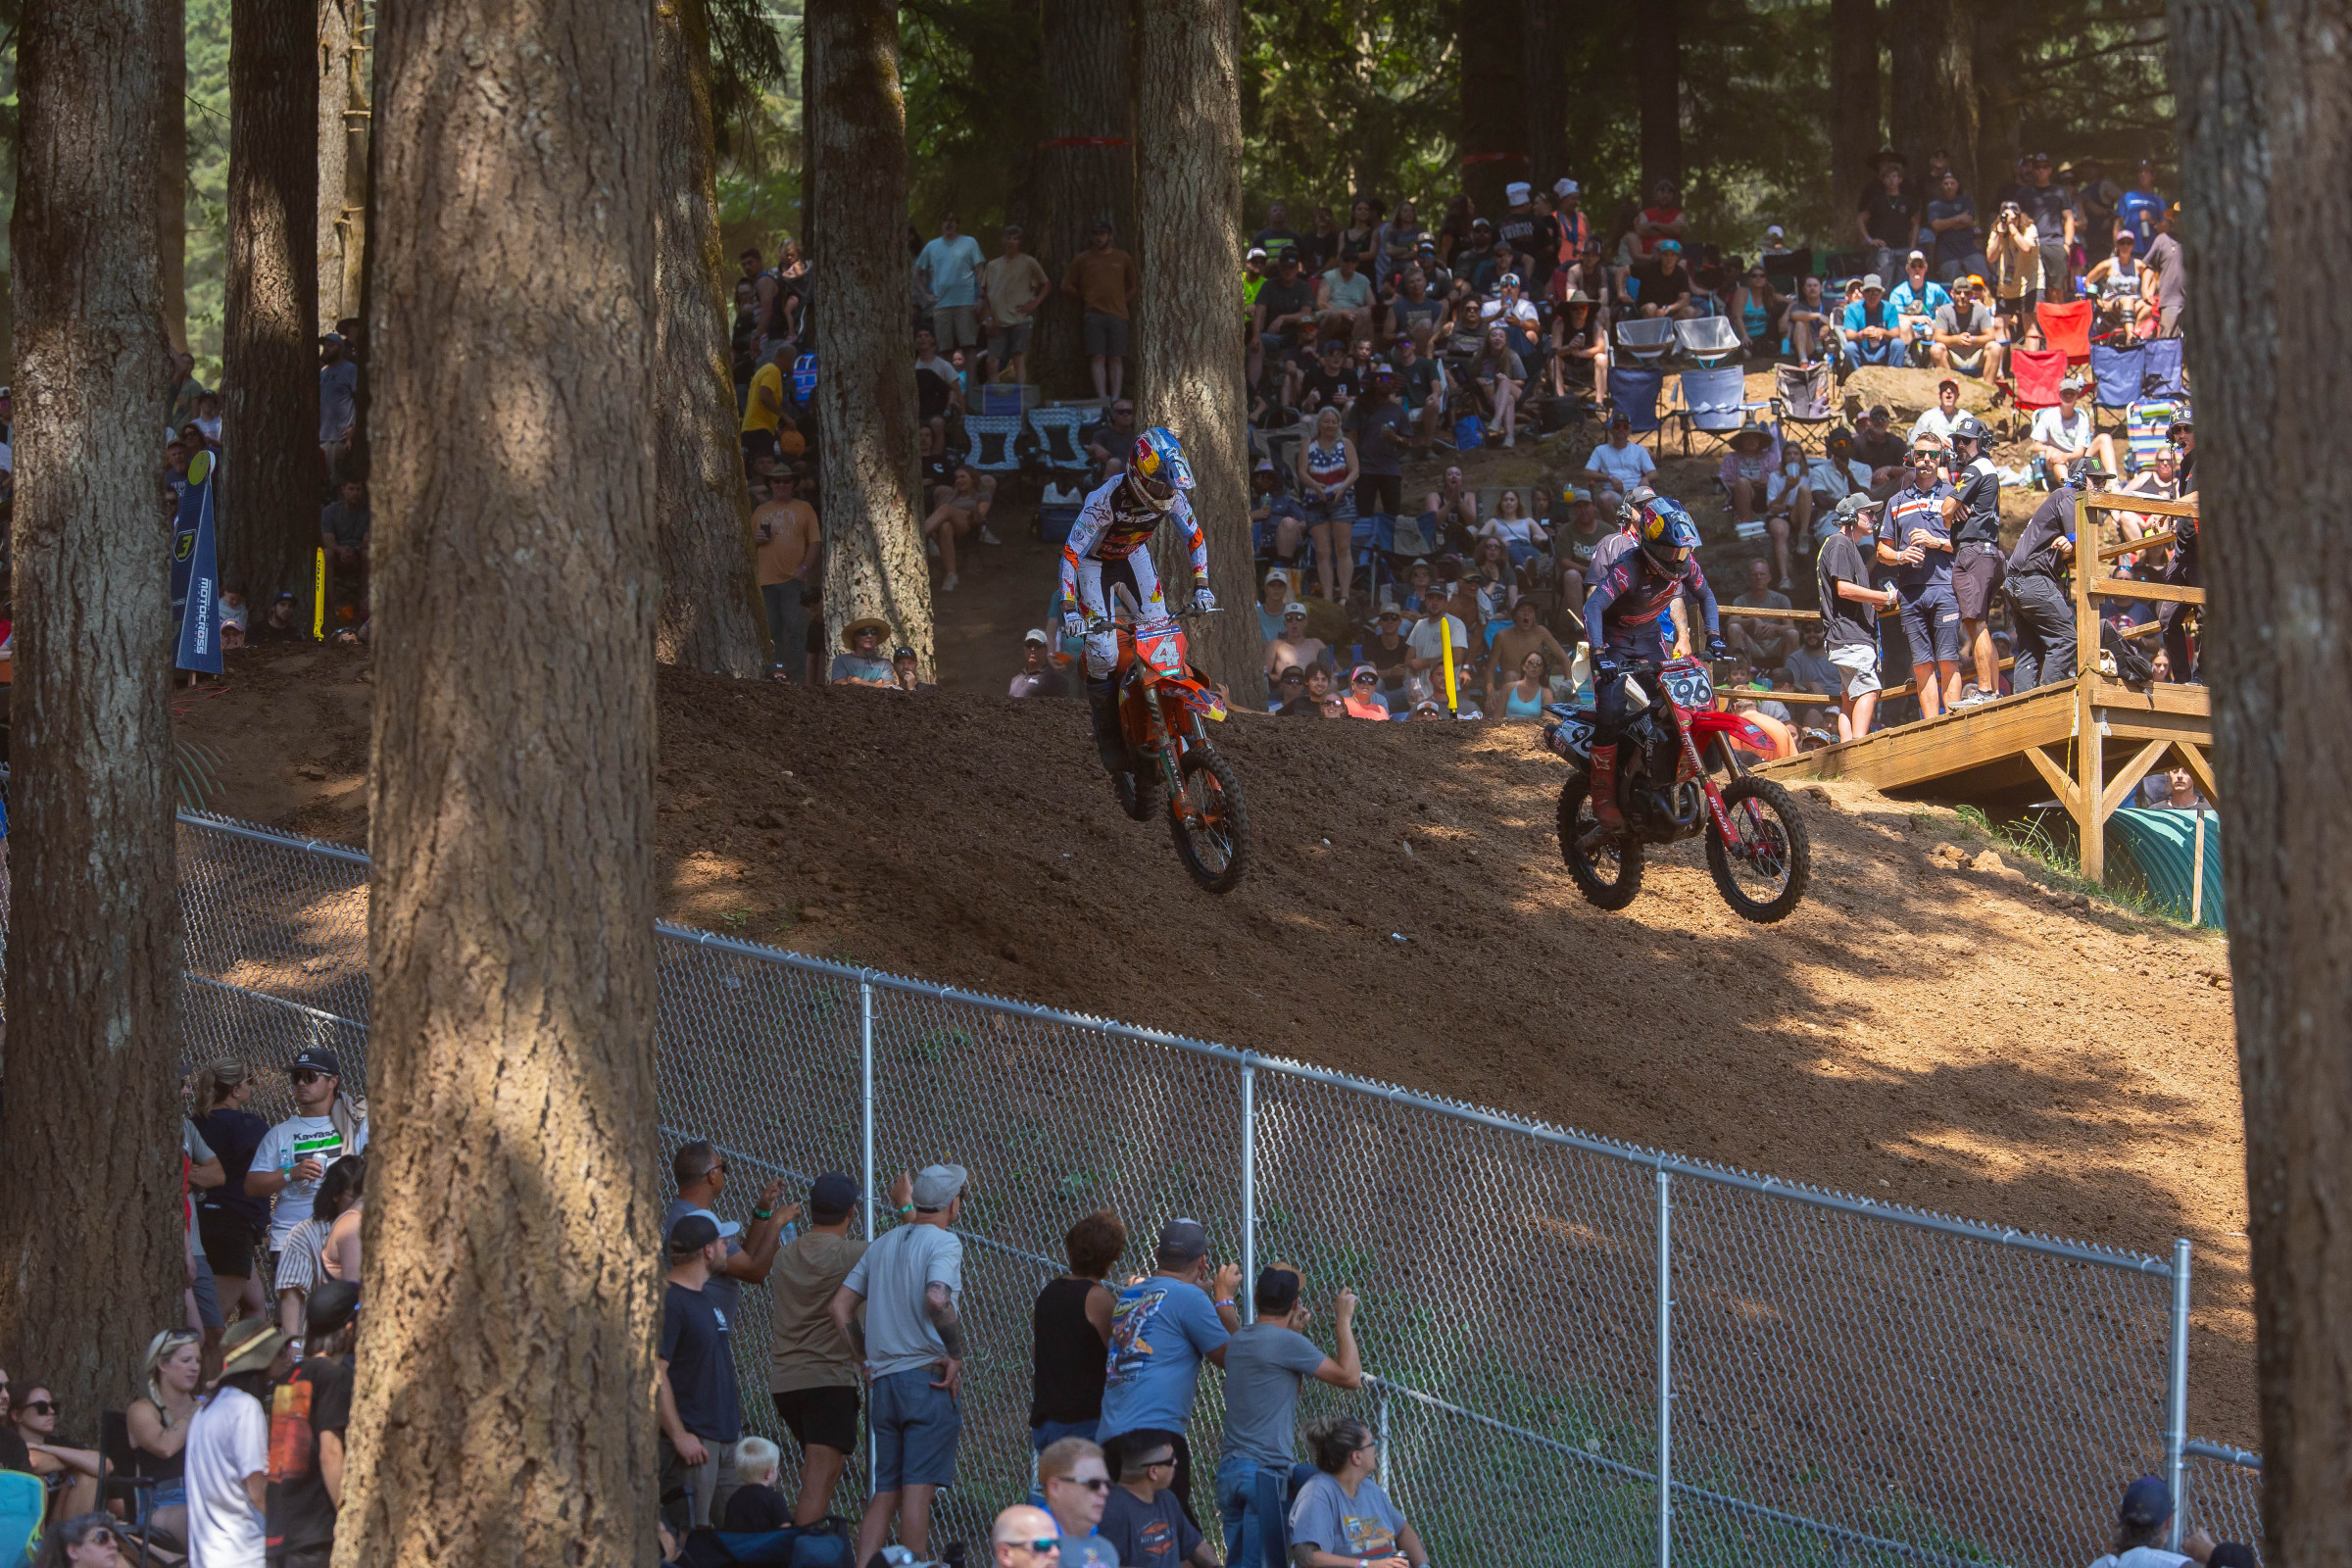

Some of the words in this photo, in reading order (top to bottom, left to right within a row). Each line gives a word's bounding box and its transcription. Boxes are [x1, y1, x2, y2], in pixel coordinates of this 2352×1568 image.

[196, 577, 209, 655] MOTOCROSS
[1150, 634, 1181, 667] 4
[1673, 678, 1711, 707] 96
